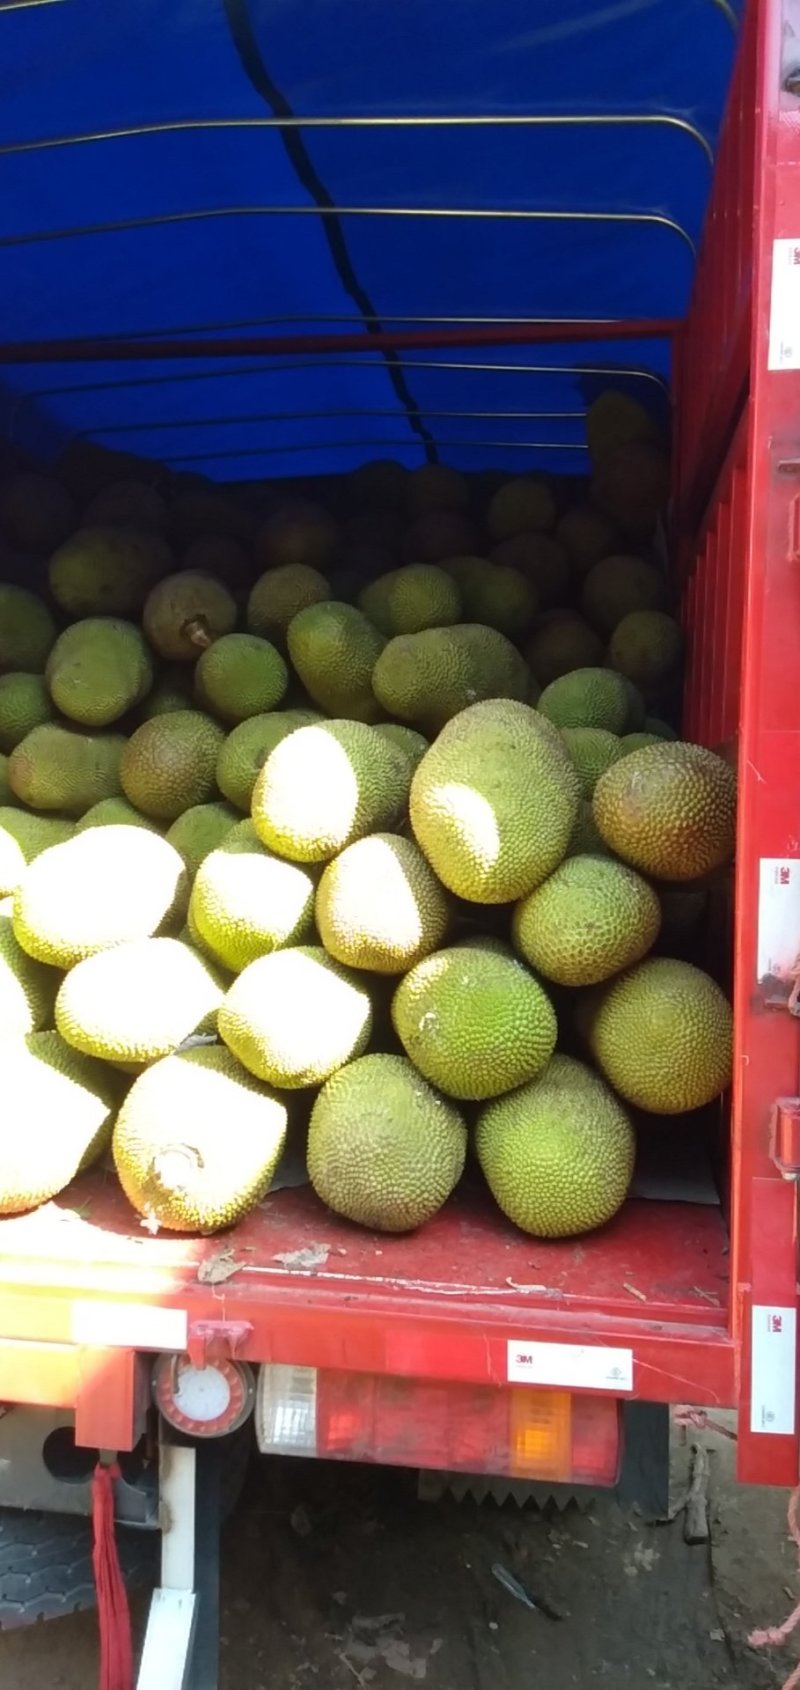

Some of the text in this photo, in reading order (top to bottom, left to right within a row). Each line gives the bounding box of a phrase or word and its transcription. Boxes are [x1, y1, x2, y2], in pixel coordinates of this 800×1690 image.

[780, 867, 789, 884] 3M
[772, 1315, 782, 1332] 3M
[515, 1354, 533, 1364] 3M
